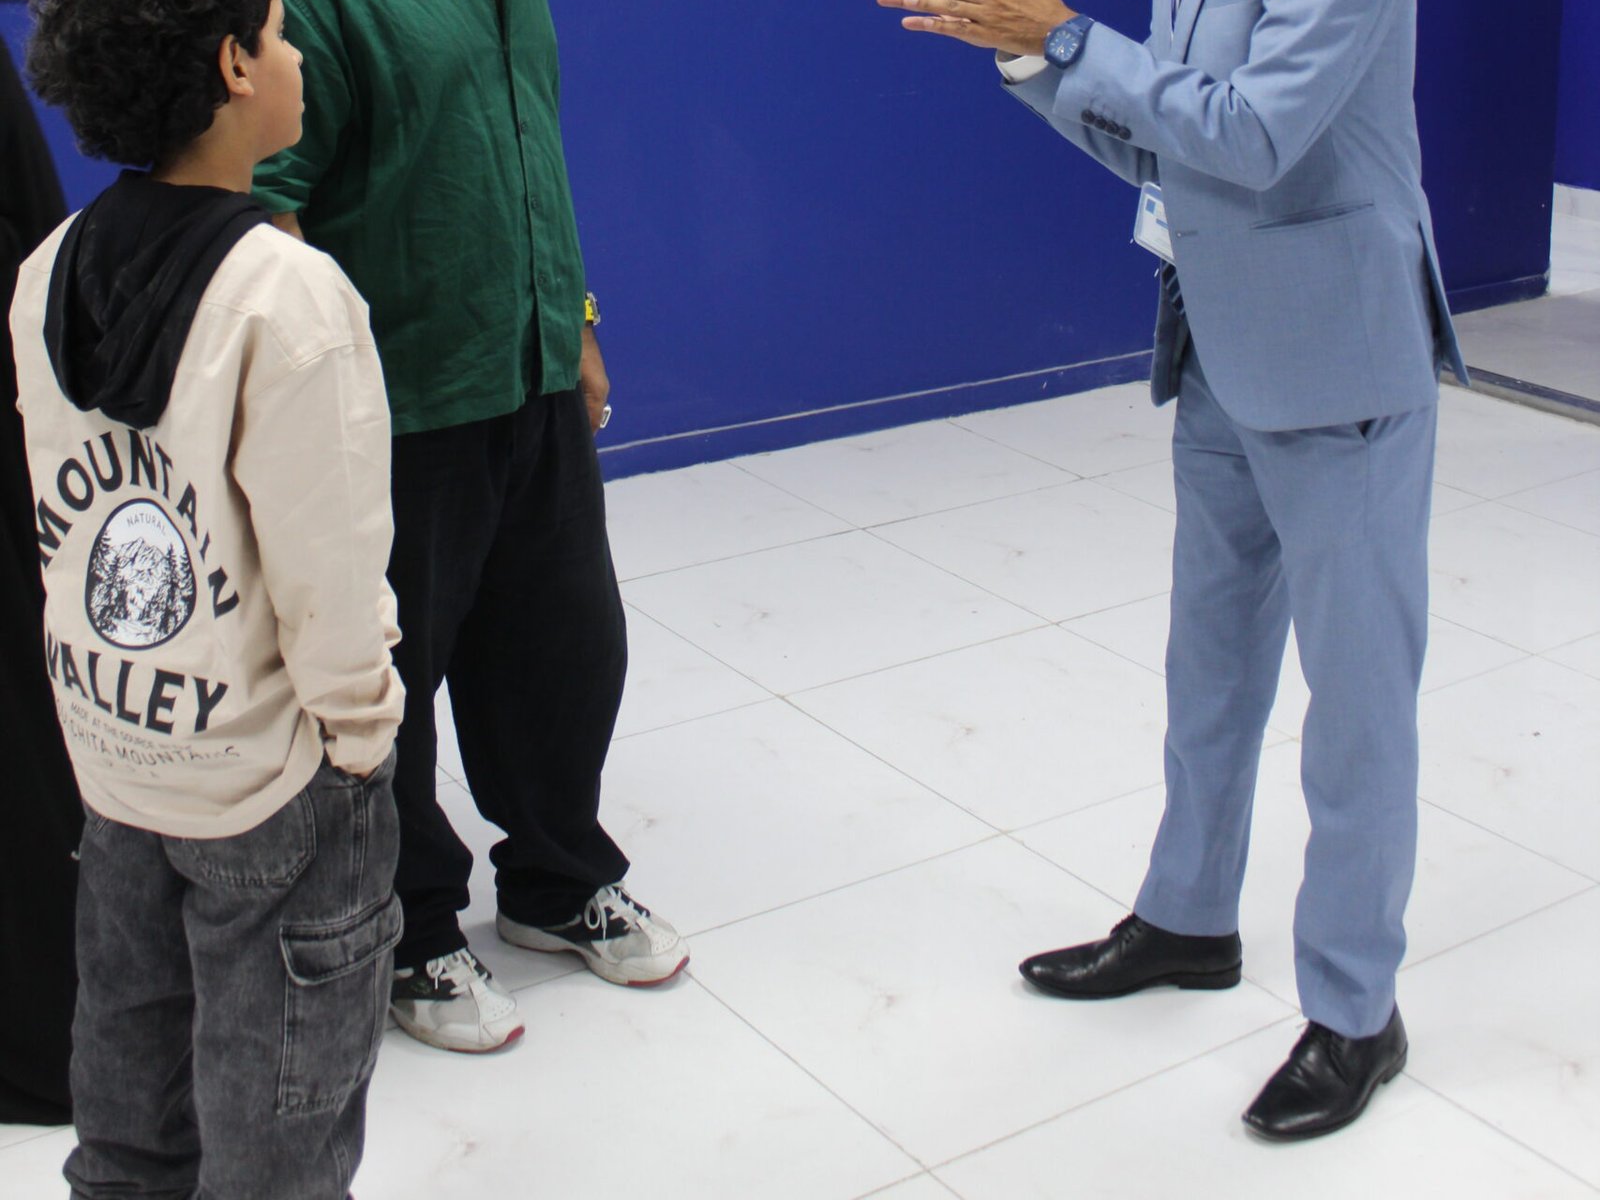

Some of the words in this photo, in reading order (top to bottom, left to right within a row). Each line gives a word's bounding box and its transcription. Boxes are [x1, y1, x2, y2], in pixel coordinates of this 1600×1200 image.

[34, 429, 240, 619] MOUNTAIN
[127, 513, 166, 536] NATURAL
[46, 631, 228, 736] VALLEY
